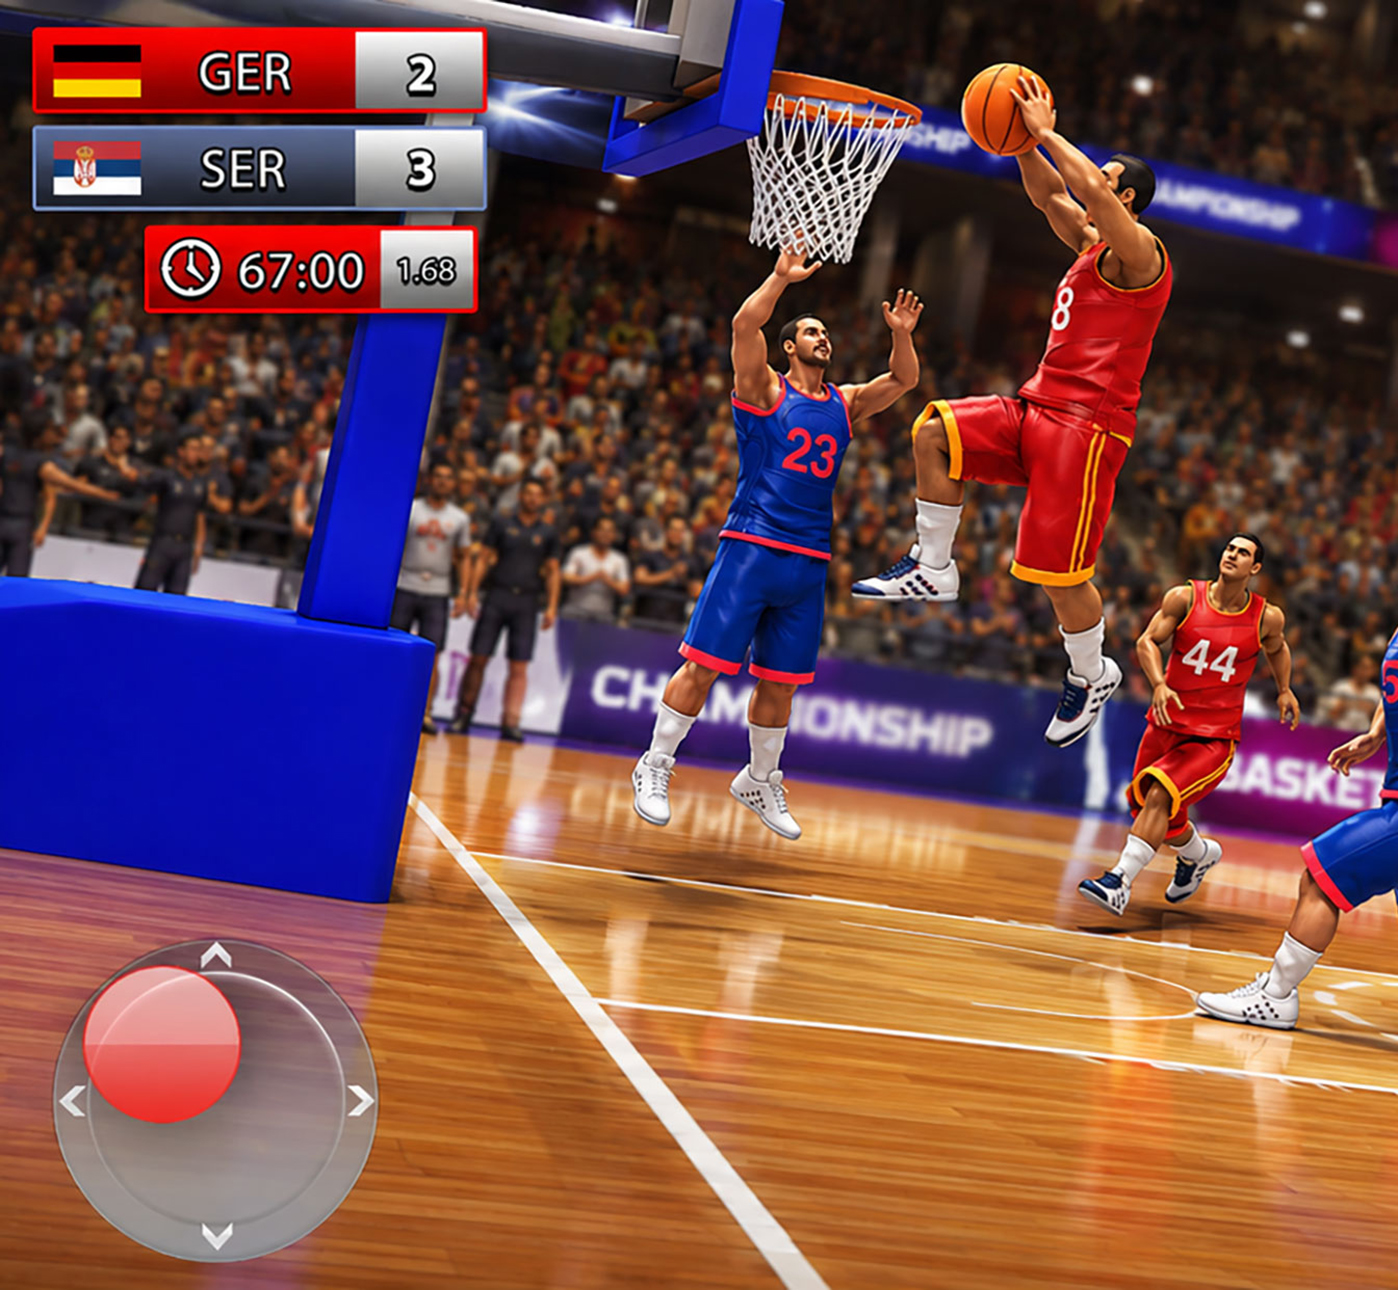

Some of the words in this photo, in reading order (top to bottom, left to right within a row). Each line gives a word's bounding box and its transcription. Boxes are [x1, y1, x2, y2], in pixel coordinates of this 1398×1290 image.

[1153, 178, 1300, 232] AMPIONSHIP
[1051, 286, 1075, 331] 8
[782, 426, 838, 479] 23
[1182, 638, 1239, 683] 44
[590, 663, 994, 758] CHMIONSHIP
